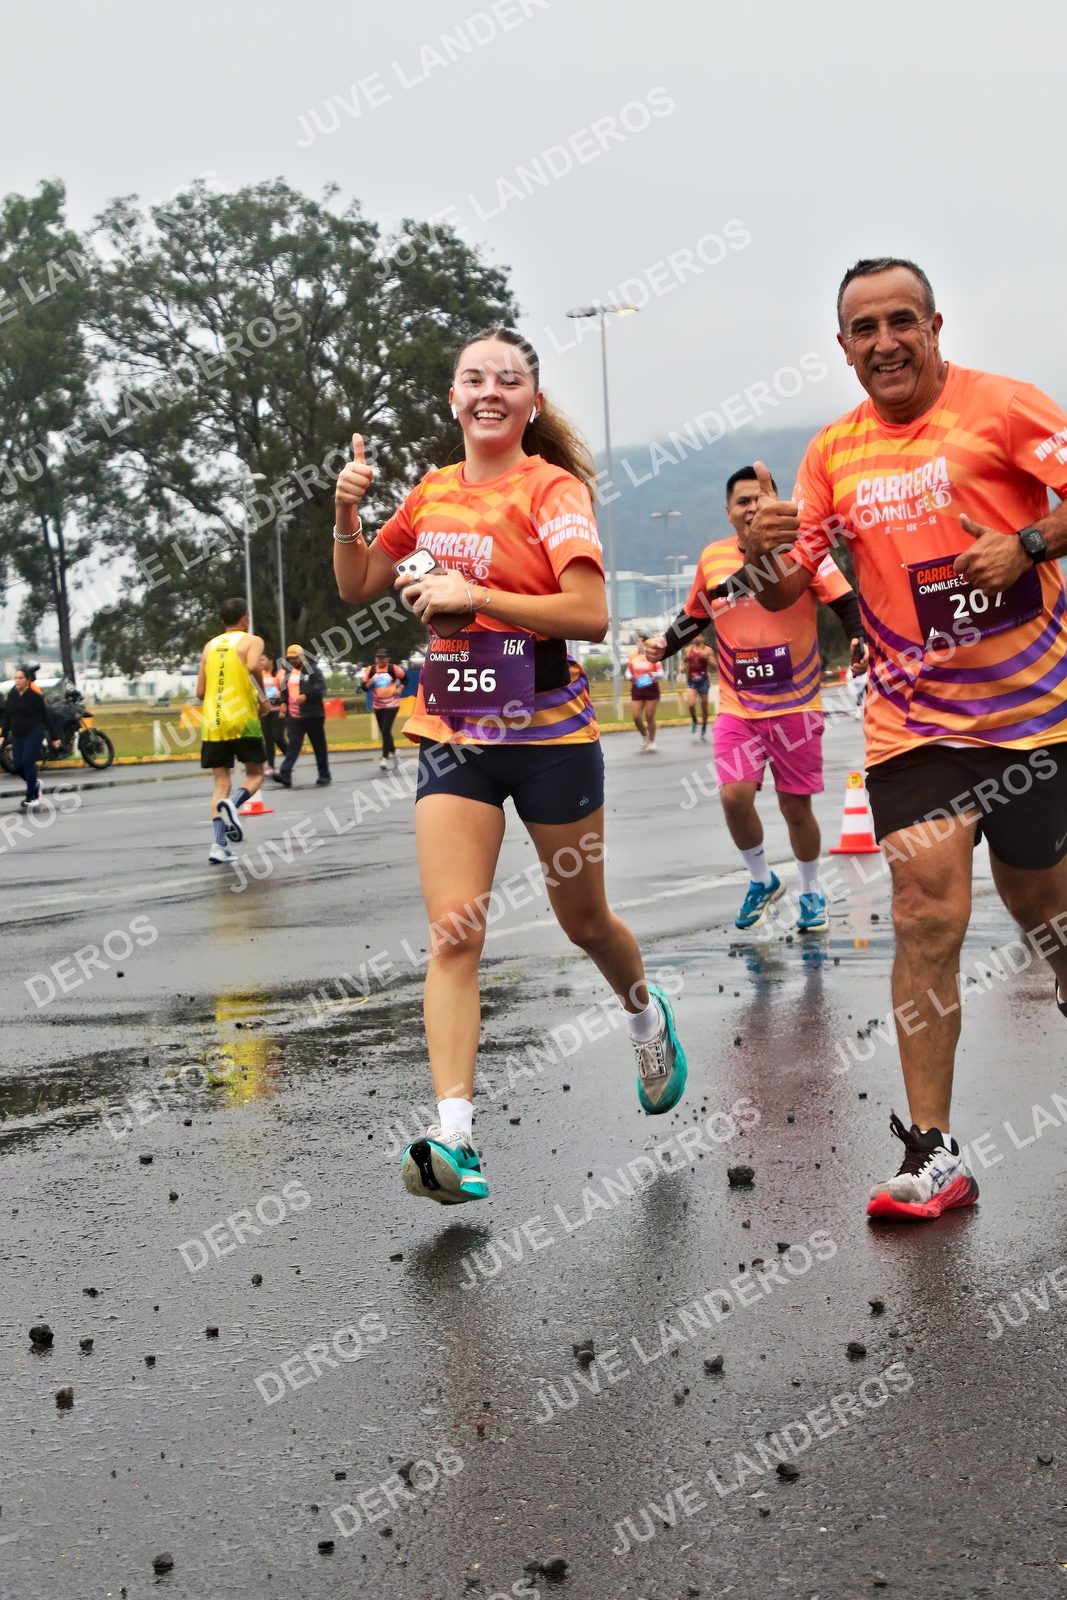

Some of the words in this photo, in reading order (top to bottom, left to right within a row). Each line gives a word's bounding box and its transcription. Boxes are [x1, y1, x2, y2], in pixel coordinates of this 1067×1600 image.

[857, 456, 949, 505] CARRERA
[861, 494, 932, 526] OMNILIFE
[416, 531, 494, 560] CARRERA
[917, 564, 958, 585] CARRE
[919, 580, 959, 594] OMNILIFE
[431, 639, 471, 652] CARRERA
[503, 639, 526, 655] 15K
[775, 647, 786, 656] 15K
[429, 653, 460, 662] OMNILIFE
[746, 664, 774, 678] 613
[447, 668, 497, 693] 256
